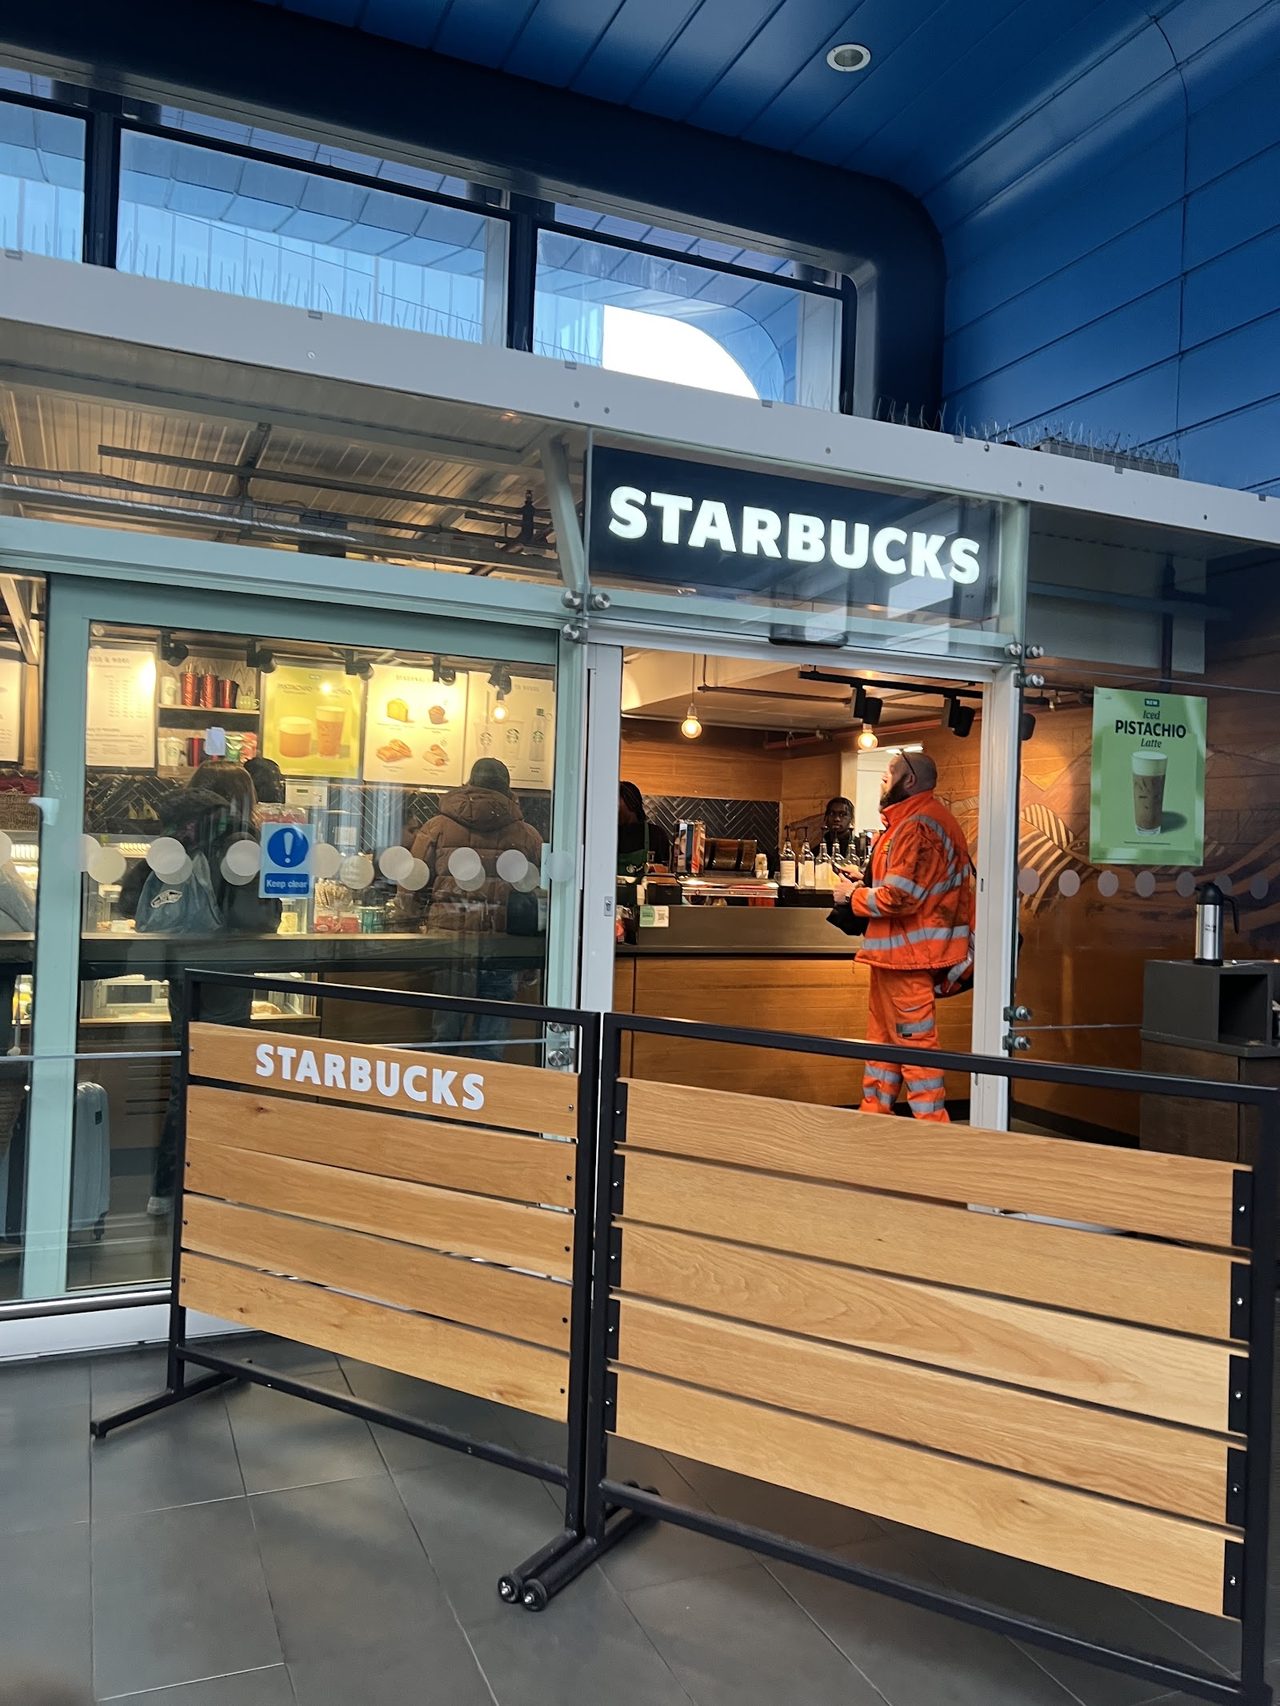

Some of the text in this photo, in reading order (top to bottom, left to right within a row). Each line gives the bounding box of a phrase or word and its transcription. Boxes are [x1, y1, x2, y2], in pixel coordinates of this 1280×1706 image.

[608, 485, 981, 585] STARBUCKS
[1143, 710, 1160, 720] Iced
[1115, 719, 1187, 738] PISTACHIO
[1140, 738, 1162, 748] Latte
[266, 879, 308, 889] Keep clear
[255, 1043, 485, 1111] STARBUCKS
